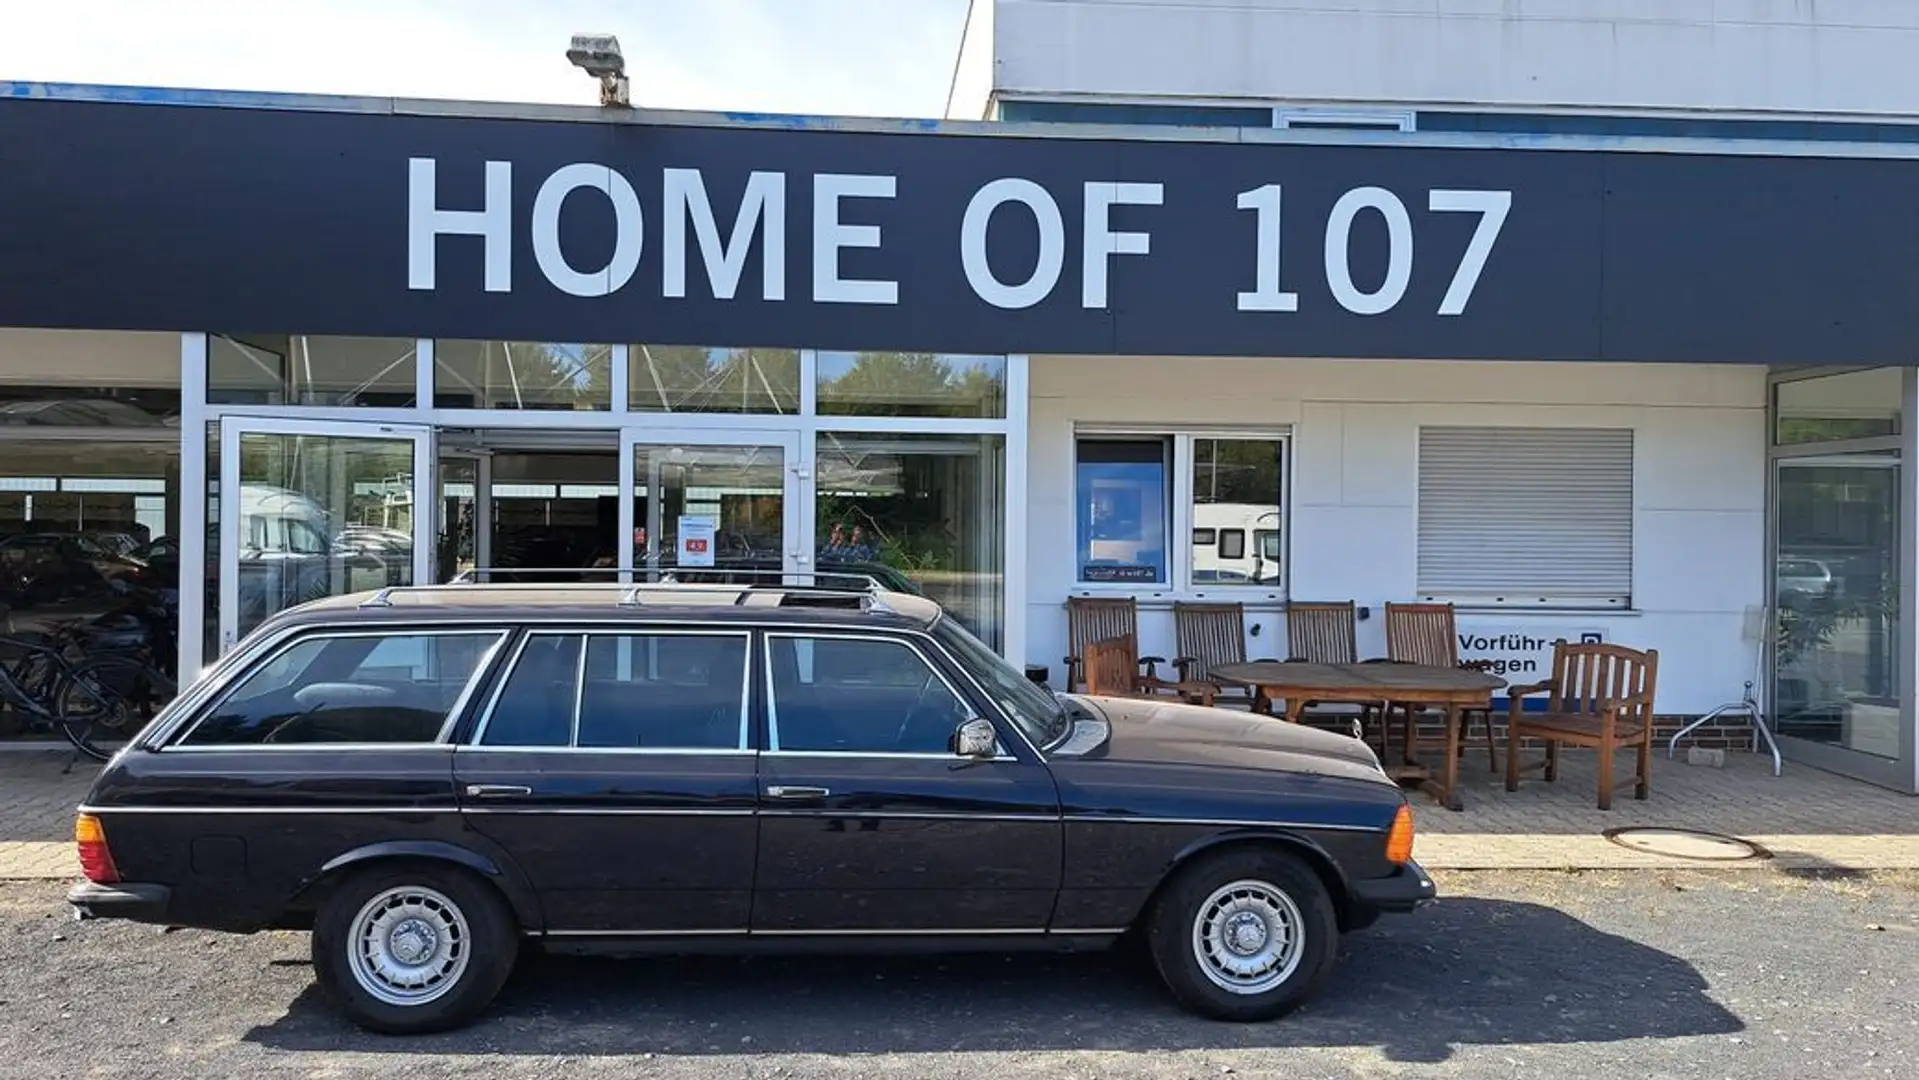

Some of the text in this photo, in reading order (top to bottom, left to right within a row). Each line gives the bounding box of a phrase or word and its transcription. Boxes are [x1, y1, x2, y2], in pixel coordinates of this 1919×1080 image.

[408, 157, 1513, 315] HOME OF 107
